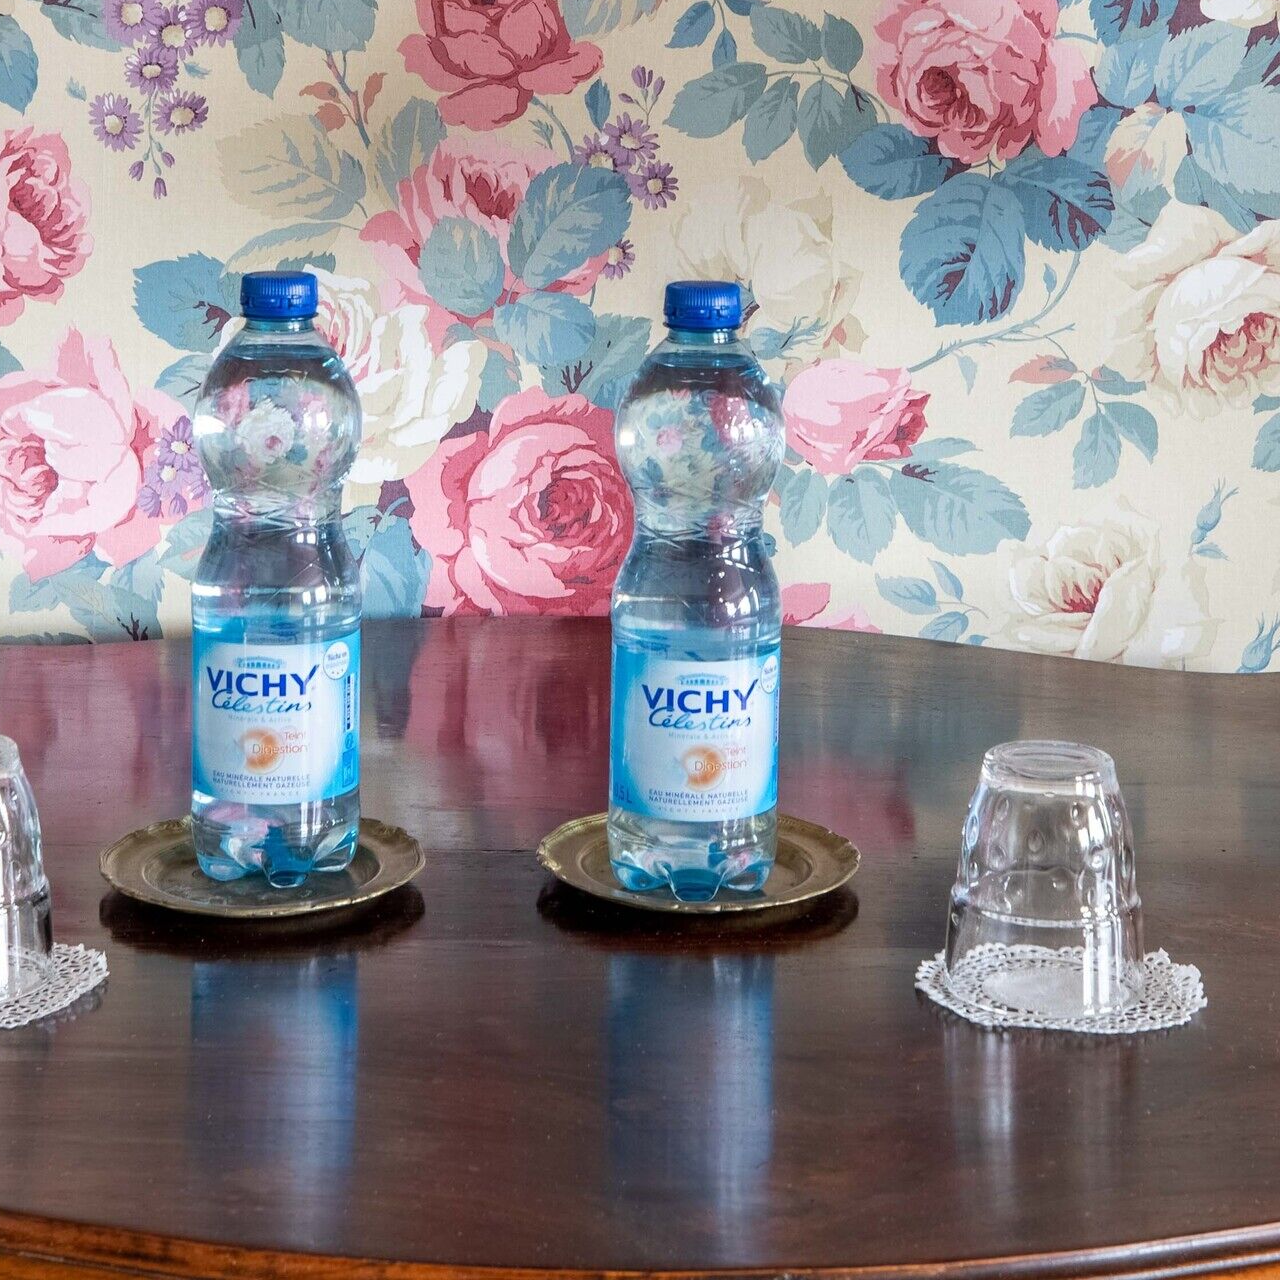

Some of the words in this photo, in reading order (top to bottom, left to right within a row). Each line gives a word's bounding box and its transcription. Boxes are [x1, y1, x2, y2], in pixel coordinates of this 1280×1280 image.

[206, 663, 319, 697] VICHY
[642, 677, 759, 713] VICHY
[211, 688, 312, 714] Célestins
[648, 706, 752, 731] Célestins
